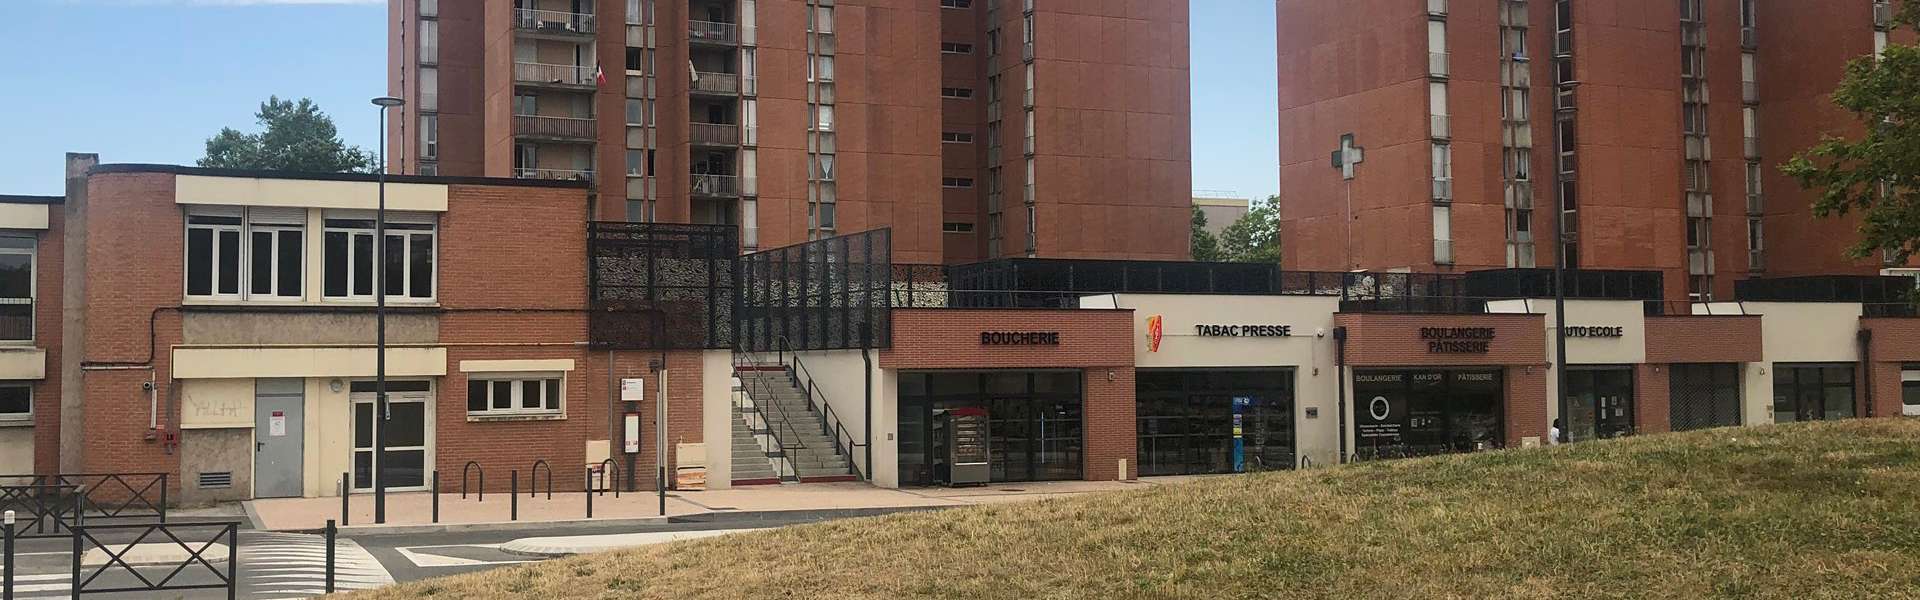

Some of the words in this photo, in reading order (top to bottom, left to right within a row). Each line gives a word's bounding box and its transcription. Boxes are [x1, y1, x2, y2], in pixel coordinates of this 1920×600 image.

[1195, 324, 1239, 337] TABAC
[1242, 325, 1291, 337] PRESSE
[1421, 327, 1496, 339] BOULANGERIE
[1564, 326, 1587, 337] UTO
[1589, 326, 1623, 337] ECOLE
[981, 331, 1060, 345] BOUCHERIE
[1355, 374, 1402, 382] BOULANGERIE
